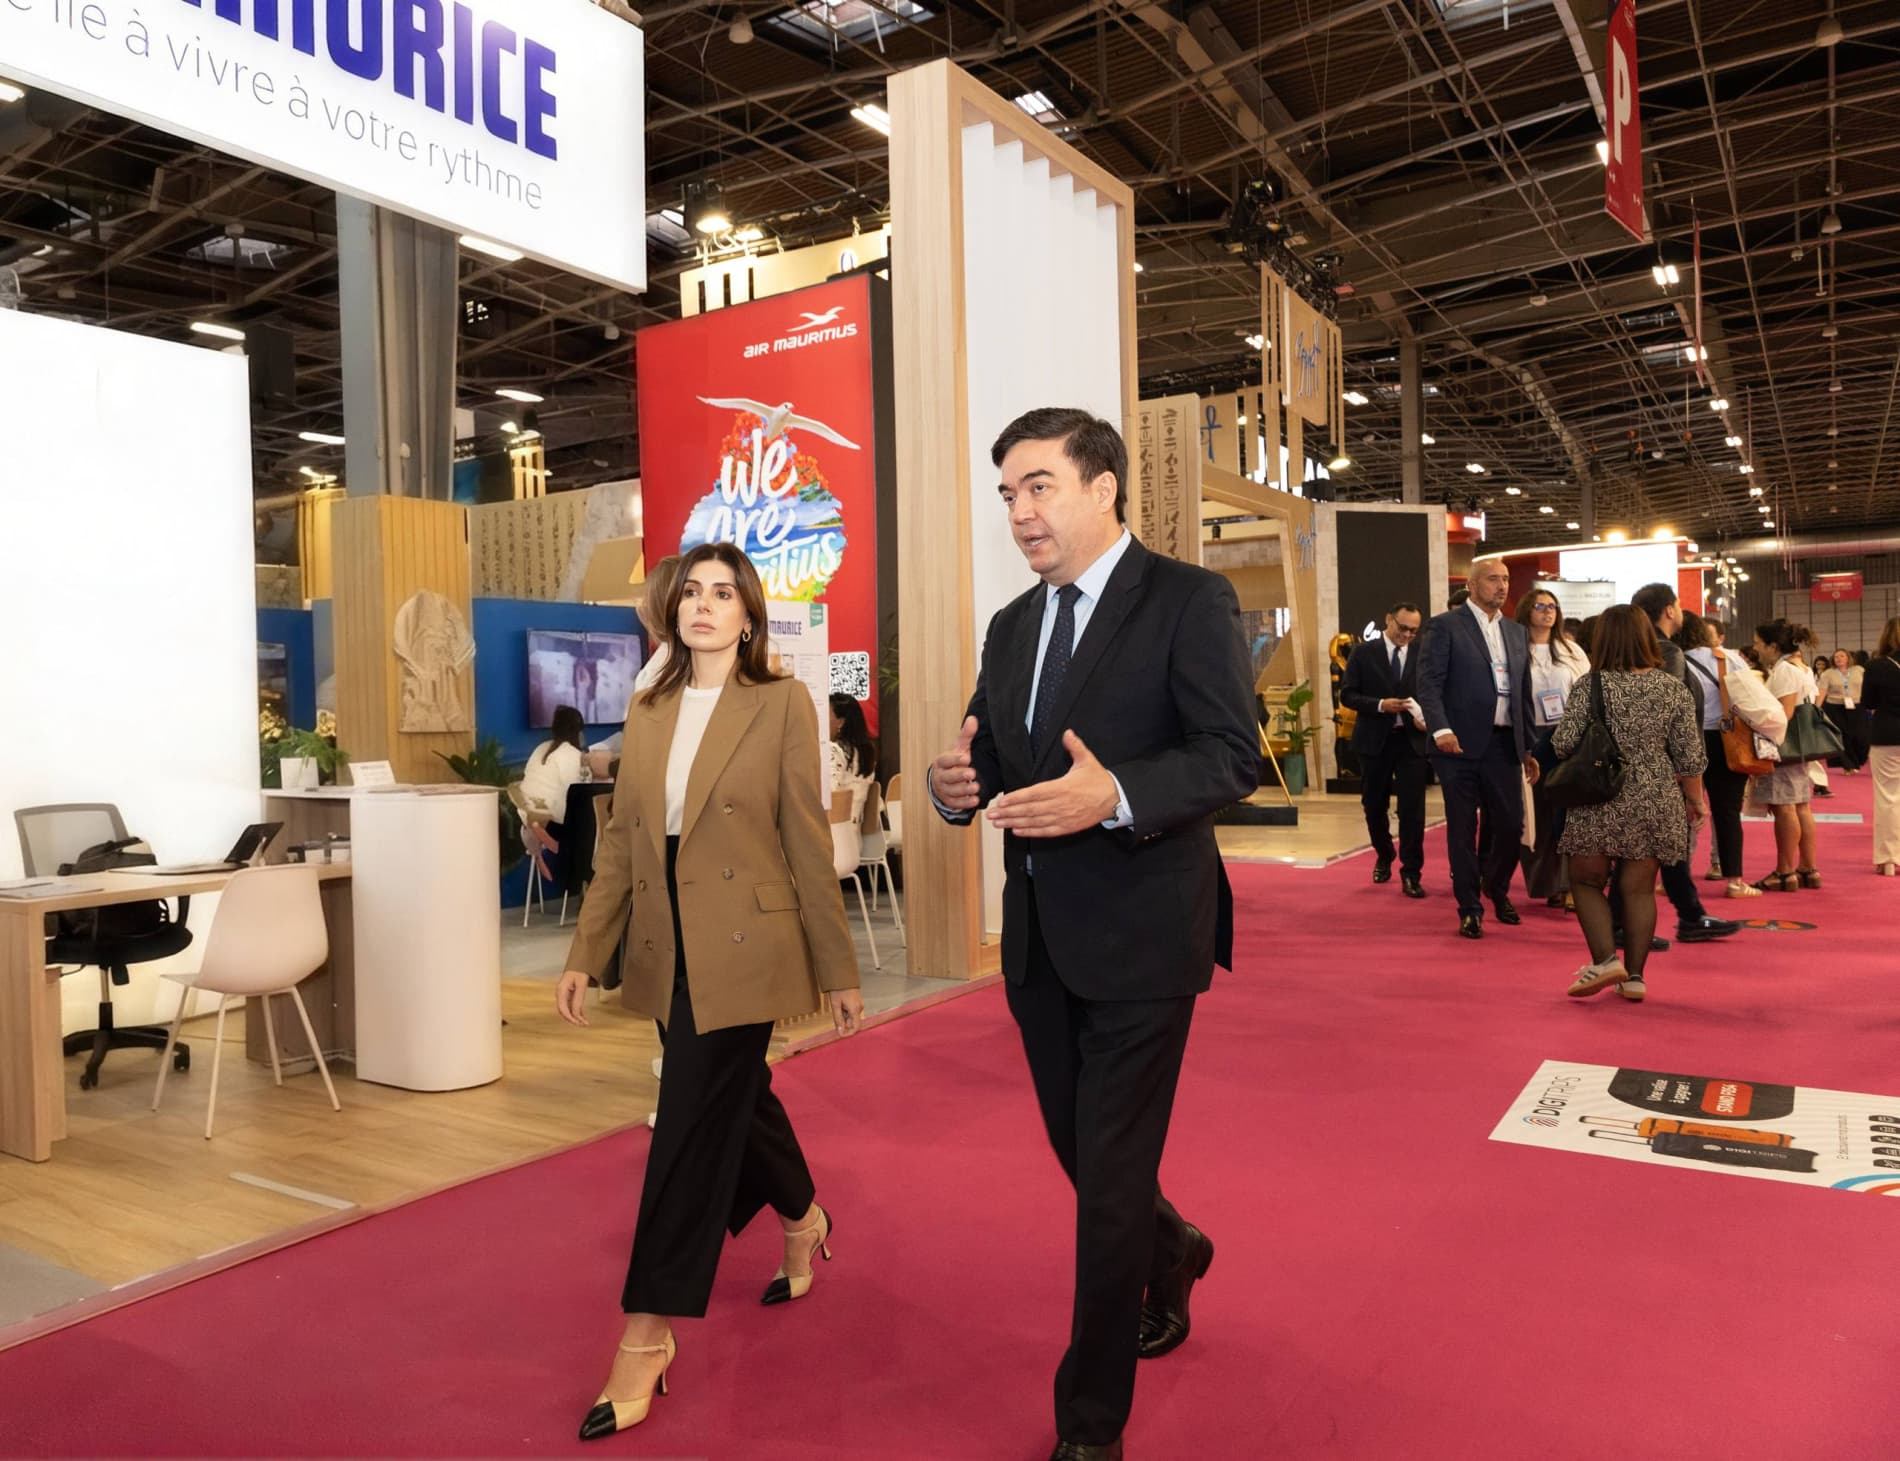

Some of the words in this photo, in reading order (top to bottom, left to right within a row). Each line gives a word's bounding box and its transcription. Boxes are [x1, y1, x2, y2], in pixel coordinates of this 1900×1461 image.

[125, 8, 149, 58] à
[167, 35, 275, 105] vivre
[288, 74, 310, 120] à
[322, 98, 418, 161] votre
[429, 142, 543, 210] rythme
[183, 0, 558, 162] URICE
